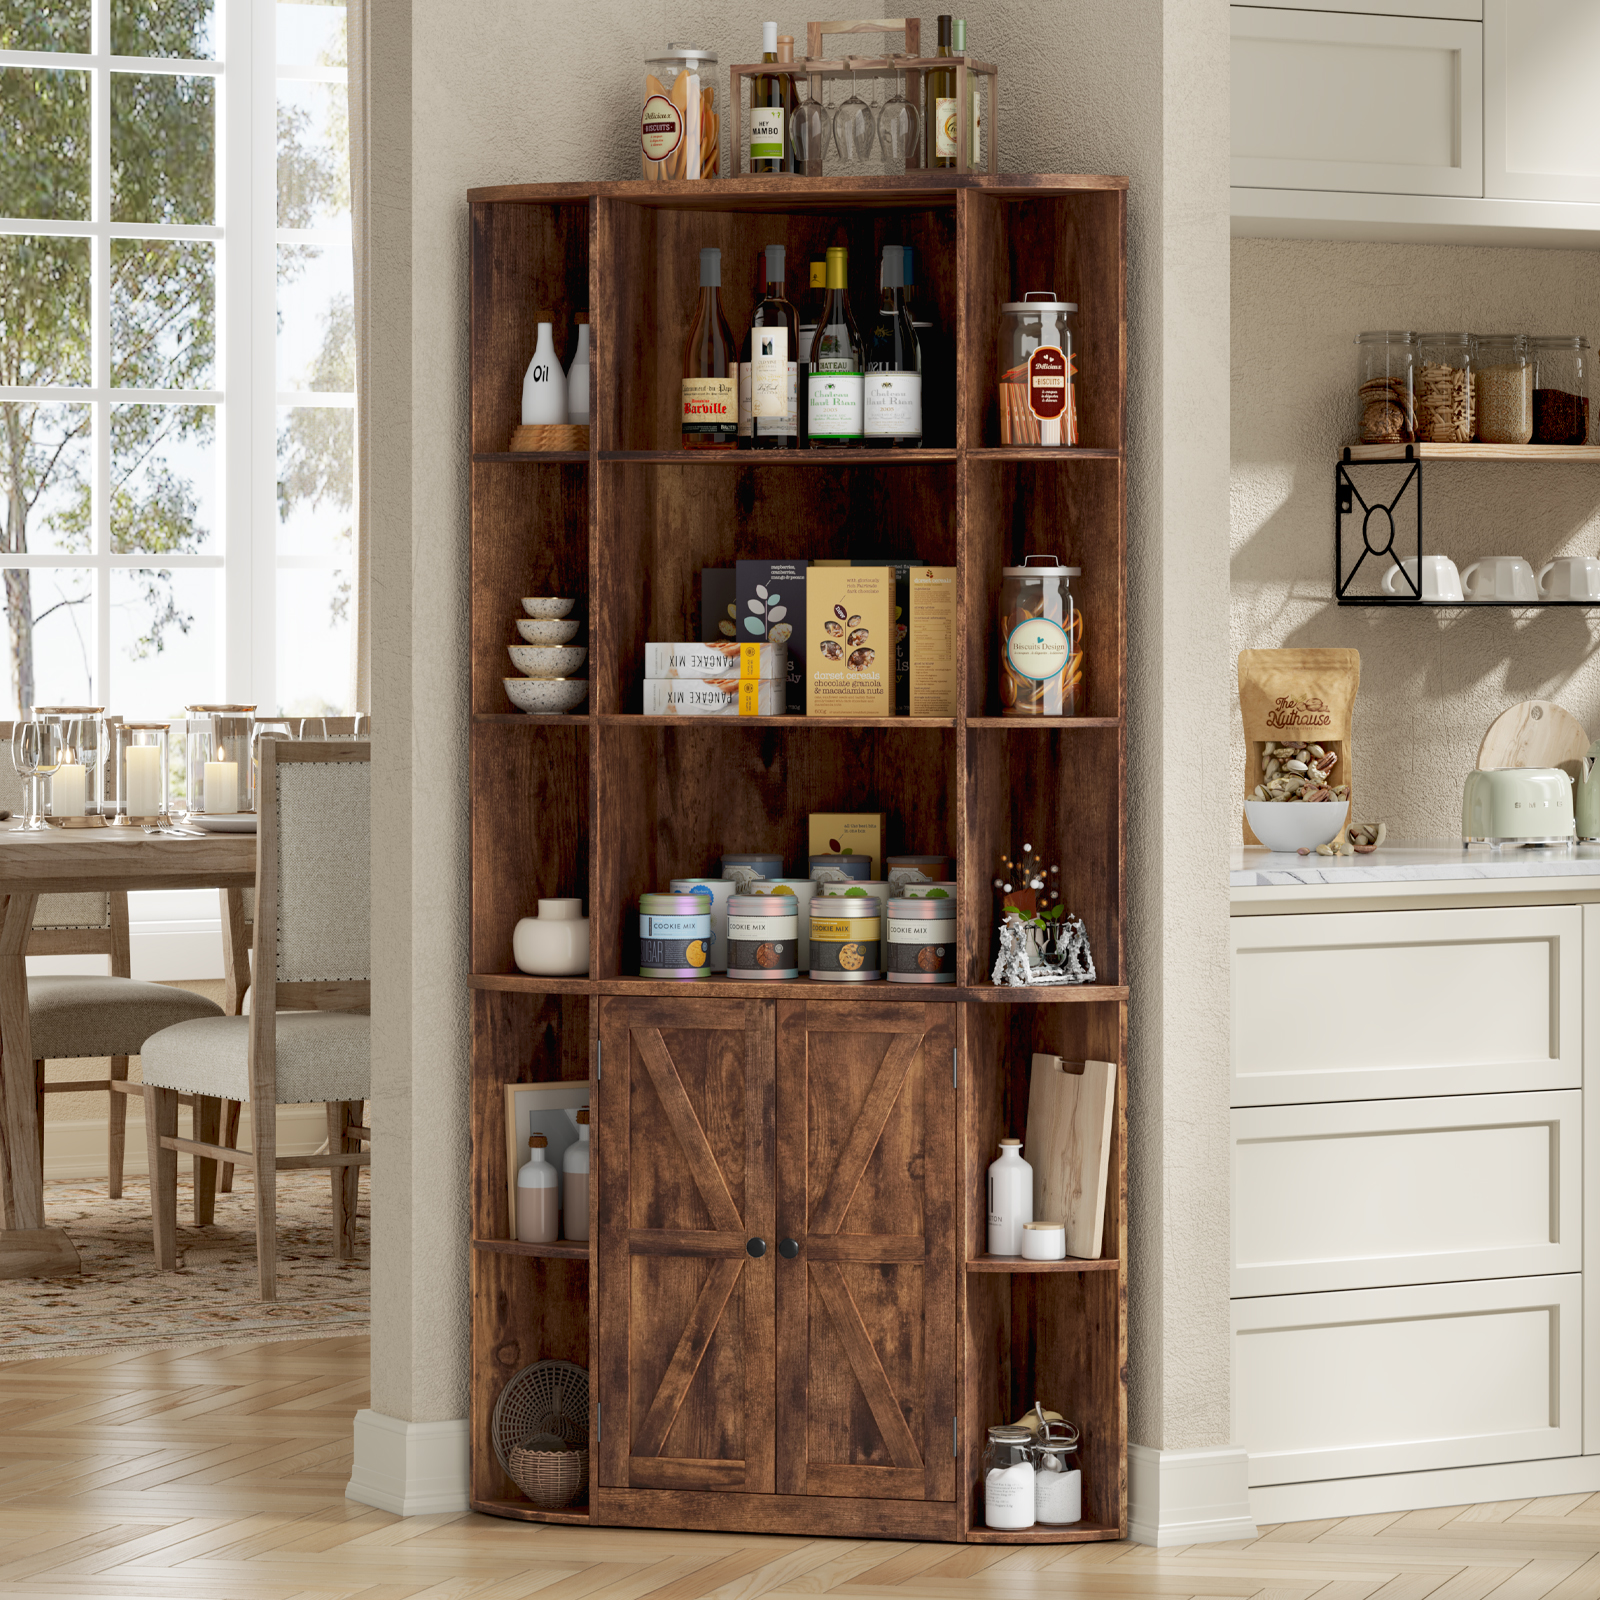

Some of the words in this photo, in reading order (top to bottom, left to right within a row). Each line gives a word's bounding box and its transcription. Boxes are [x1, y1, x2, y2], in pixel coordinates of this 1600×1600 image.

[752, 127, 779, 135] MAMBO
[533, 365, 549, 382] Oil
[1037, 378, 1061, 386] BISCUITS
[683, 403, 727, 415] Barville
[835, 605, 846, 619] new
[1042, 643, 1065, 651] Design
[669, 655, 686, 667] MIX
[691, 655, 734, 667] PANCAKE
[814, 671, 844, 680] dorset
[846, 671, 880, 680] cereals
[852, 680, 882, 688] granola
[667, 691, 684, 704] MIX
[689, 691, 733, 704] PANCAKE
[1275, 695, 1297, 711] The
[1266, 709, 1331, 729] Nuthouse
